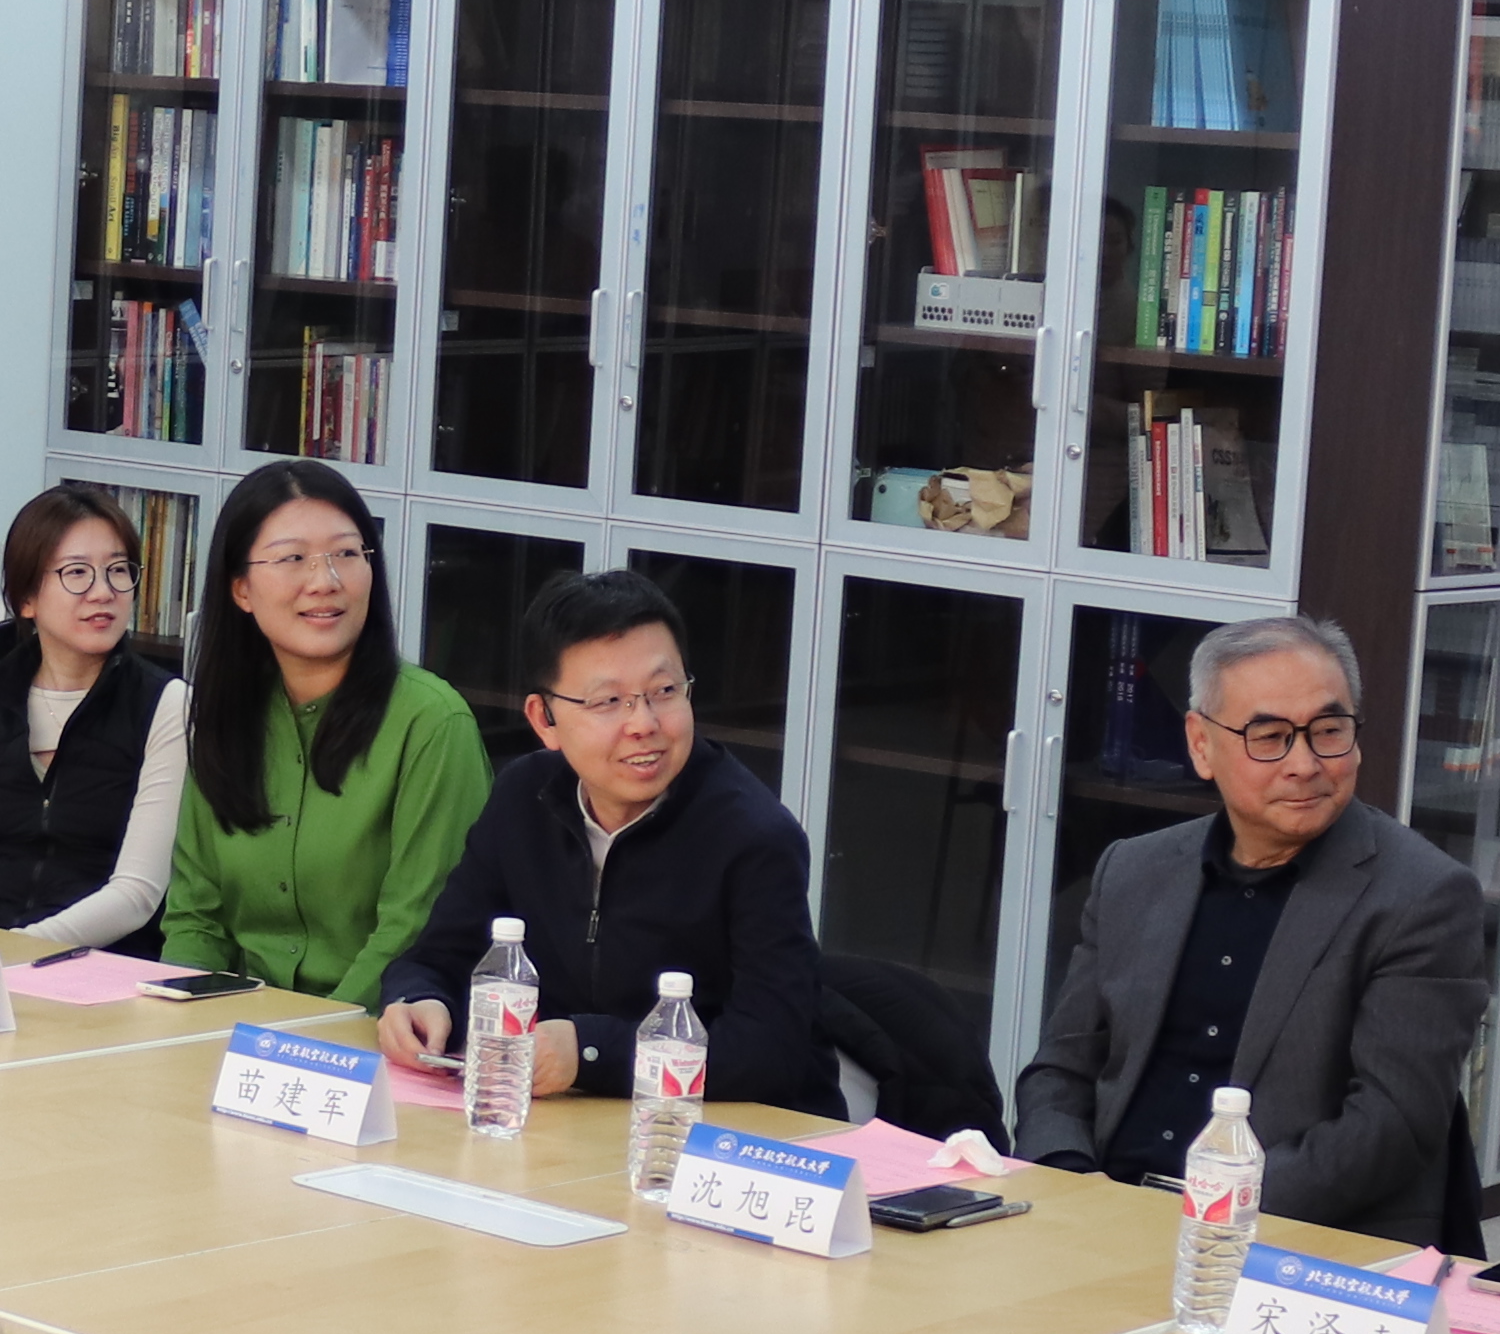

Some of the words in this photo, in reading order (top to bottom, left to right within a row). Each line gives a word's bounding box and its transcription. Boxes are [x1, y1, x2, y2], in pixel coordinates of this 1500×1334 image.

[234, 1068, 350, 1127] 苗建军
[690, 1170, 816, 1235] 沈旭昆
